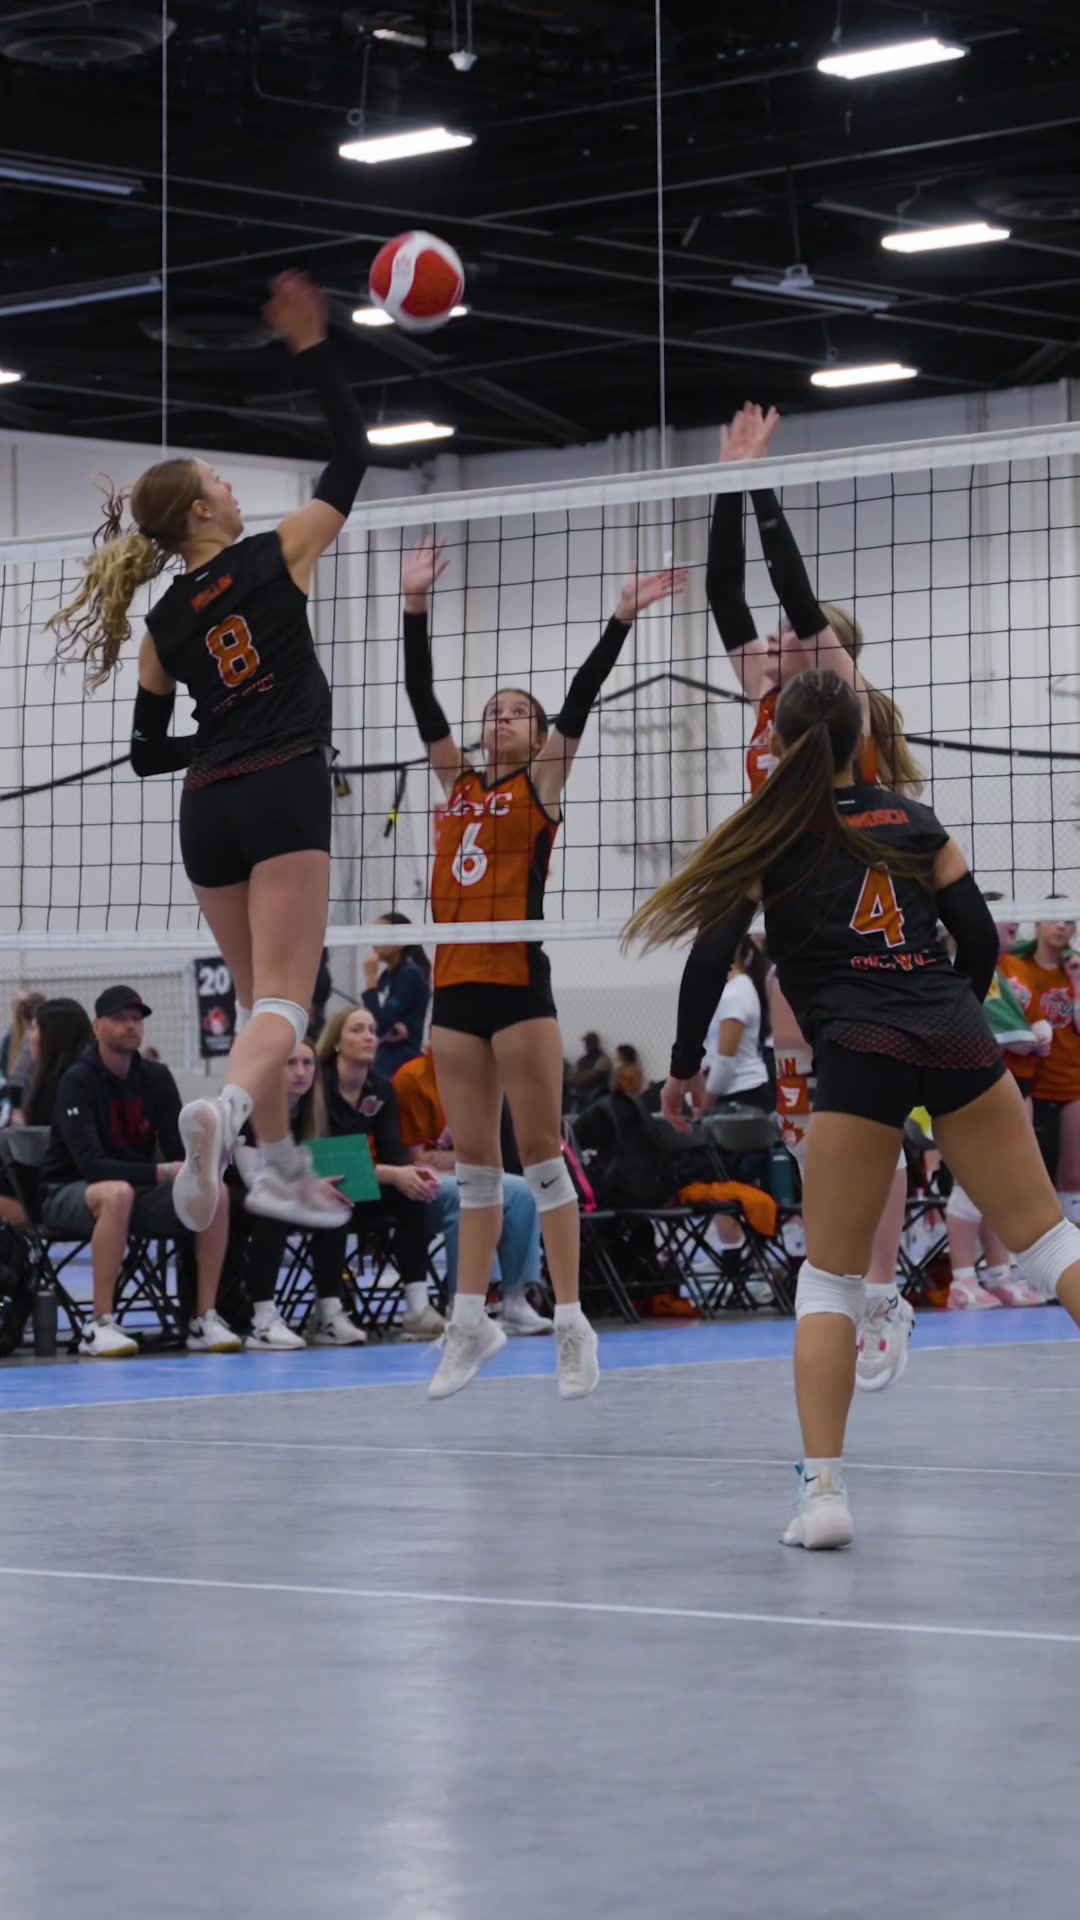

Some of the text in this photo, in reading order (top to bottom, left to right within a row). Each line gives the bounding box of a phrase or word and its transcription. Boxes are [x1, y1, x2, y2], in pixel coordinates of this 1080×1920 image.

[205, 614, 260, 688] 8
[452, 822, 488, 887] 6
[849, 861, 906, 949] 4
[199, 965, 231, 996] 20
